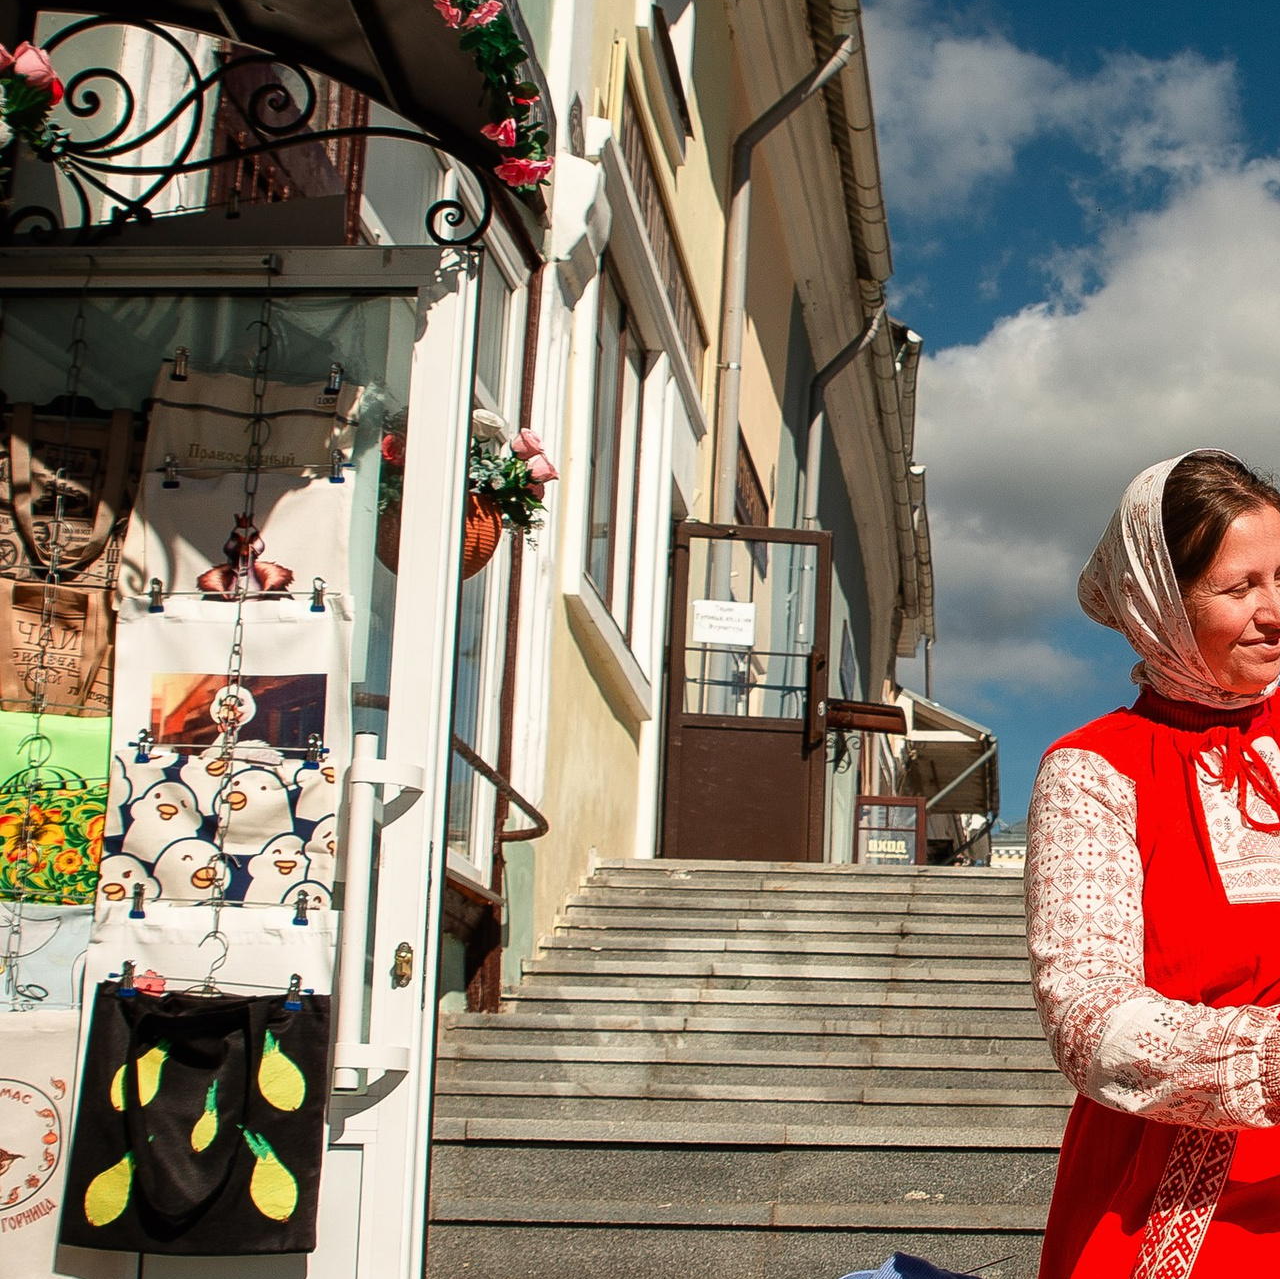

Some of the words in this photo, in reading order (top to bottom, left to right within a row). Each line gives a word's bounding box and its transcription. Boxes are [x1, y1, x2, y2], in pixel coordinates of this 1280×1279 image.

[16, 619, 82, 651] ЧАЙ
[868, 839, 907, 854] ВХОД
[0, 1088, 33, 1105] МАС
[0, 1197, 58, 1233] ГОРНИЦА
